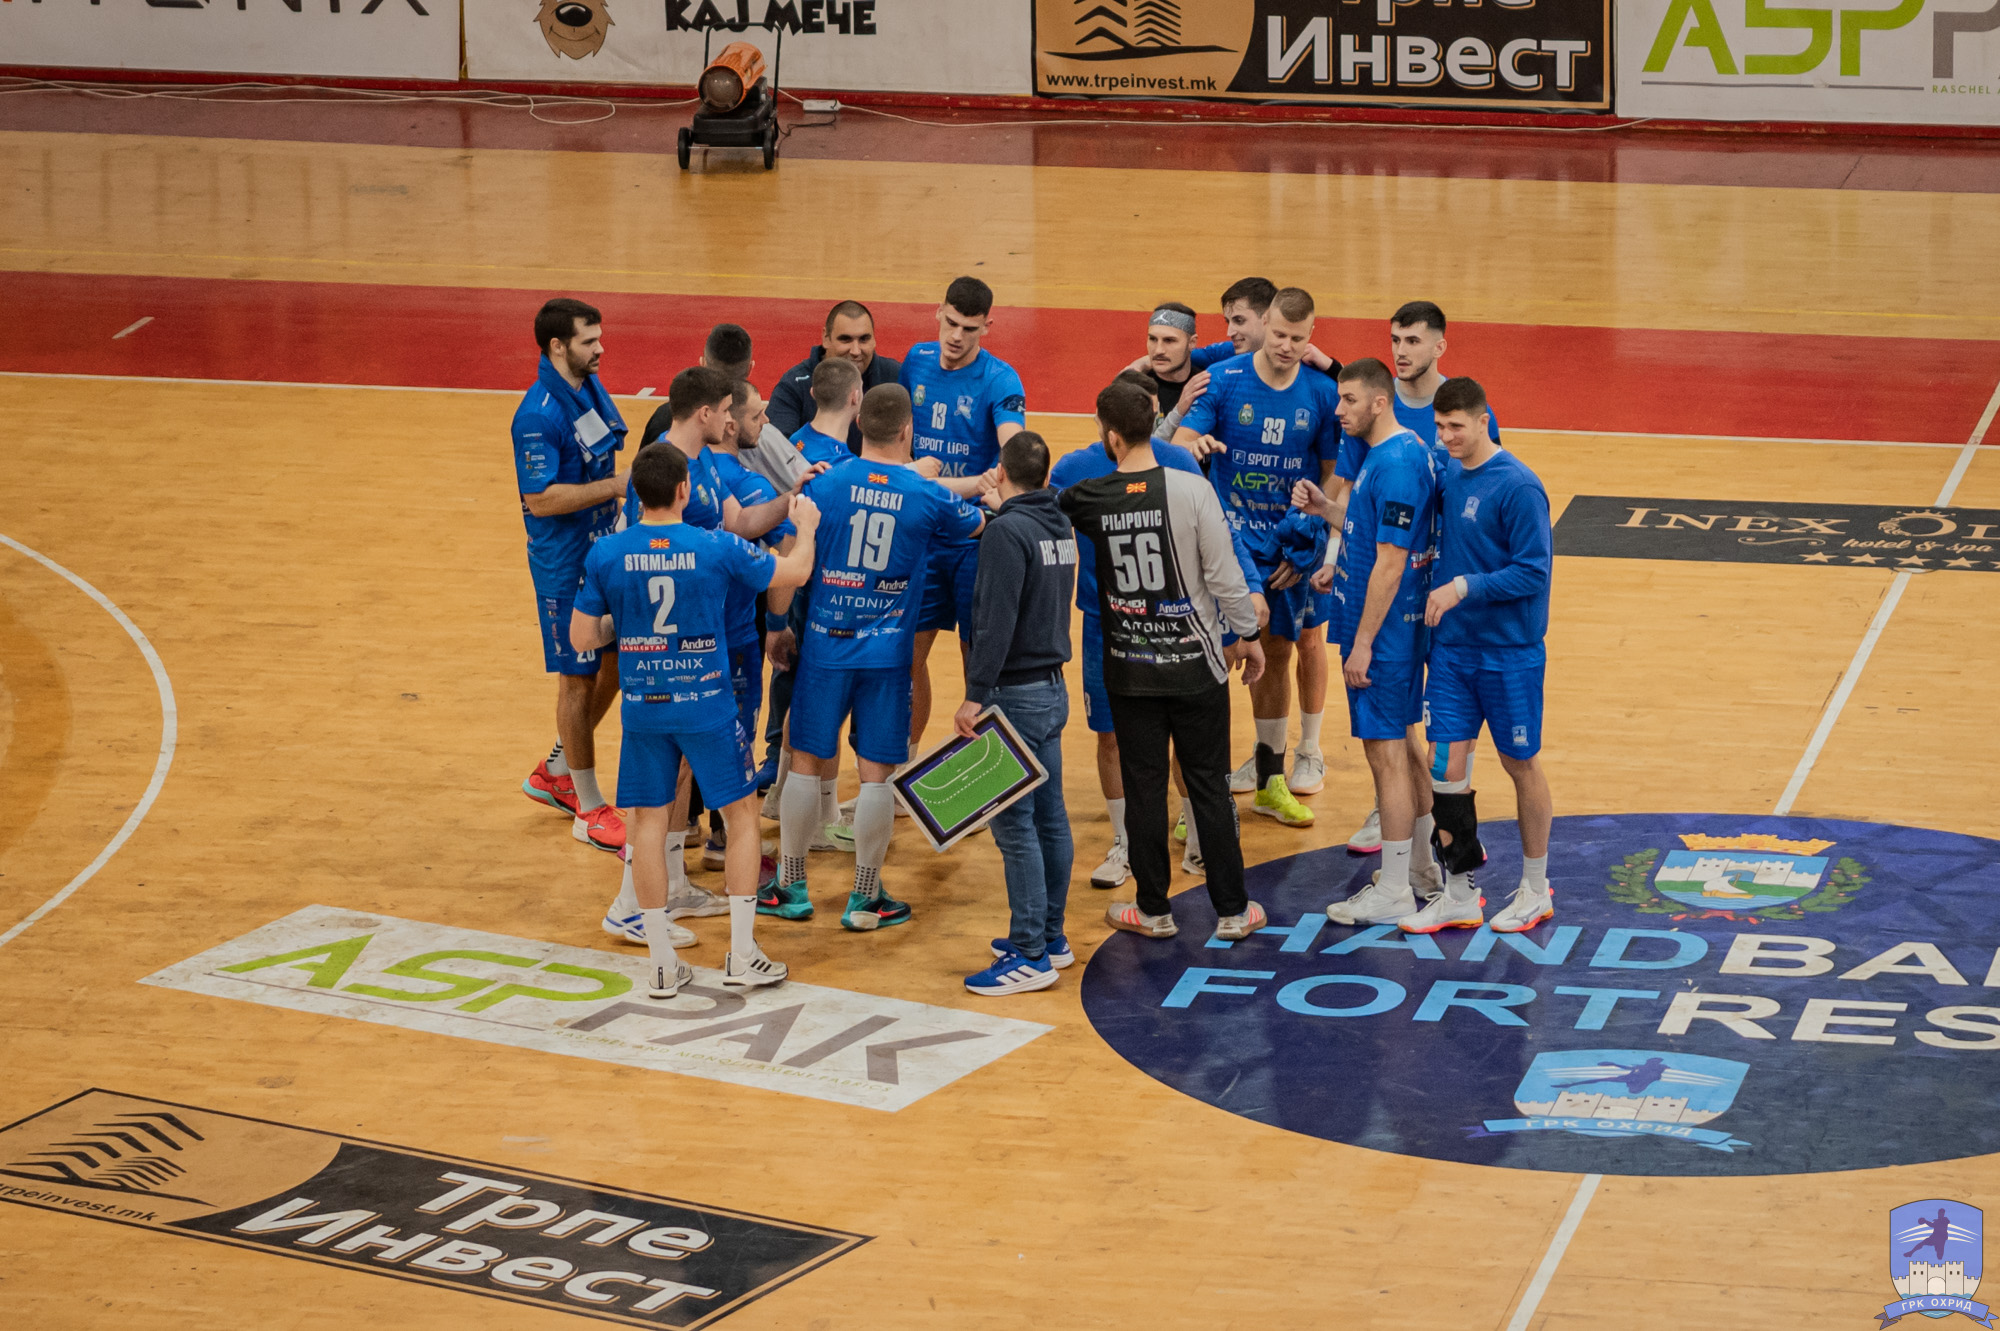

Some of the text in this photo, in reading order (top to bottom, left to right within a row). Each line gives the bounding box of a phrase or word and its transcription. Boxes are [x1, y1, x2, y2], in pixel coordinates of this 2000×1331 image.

[763, 0, 877, 36] МЕЧЕ
[1266, 14, 1590, 91] Инвест
[1642, 0, 2000, 79] ASPP
[1046, 72, 1217, 92] www.trpeinvest.mk
[1932, 84, 1991, 95] RASCHEL
[931, 402, 947, 430] 13
[1261, 417, 1286, 445] 33
[850, 484, 904, 512] TASESKI
[1101, 509, 1162, 531] PILIPOVIC
[1615, 507, 1850, 535] INEX
[847, 508, 896, 571] 19
[1842, 538, 1995, 554] hotel & spa
[624, 552, 696, 572] STRMLJAN
[1108, 532, 1166, 593] 56
[647, 575, 678, 635] 2
[830, 593, 895, 609] AITONIX
[1159, 602, 1191, 614] Andros
[681, 638, 716, 650] Andros
[636, 657, 704, 671] AITONIX
[1204, 912, 2000, 987] HANDBA
[554, 1029, 627, 1048] RASCHEL
[819, 1074, 894, 1093] FABRICS
[1526, 1119, 1694, 1137] ГРК ОХРИД
[0, 1182, 160, 1222] rpeinvest.mk
[415, 1171, 717, 1261] Трпе
[232, 1197, 723, 1313] Инвест
